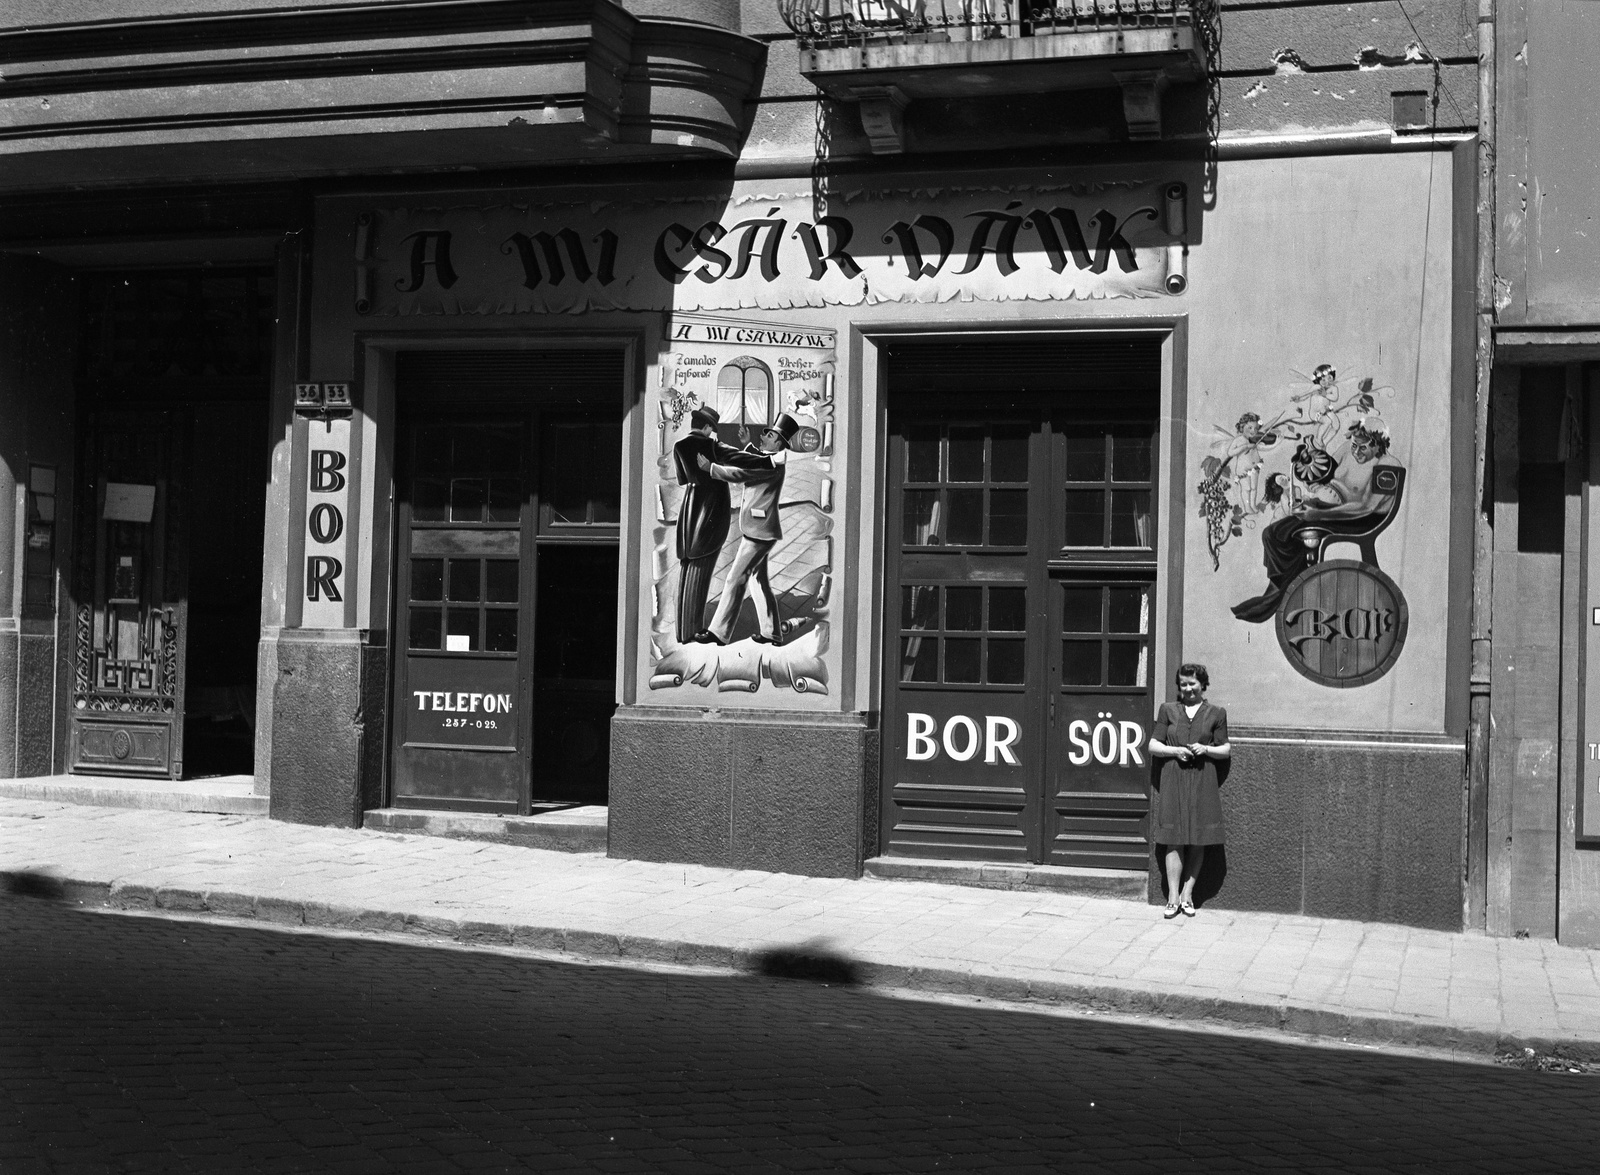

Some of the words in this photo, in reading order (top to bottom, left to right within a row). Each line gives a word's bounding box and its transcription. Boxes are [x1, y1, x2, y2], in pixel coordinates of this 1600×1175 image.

[394, 230, 460, 293] A
[673, 324, 692, 340] A
[306, 449, 347, 603] BOR
[906, 712, 1023, 766] BOR
[1068, 711, 1147, 768] SÖR
